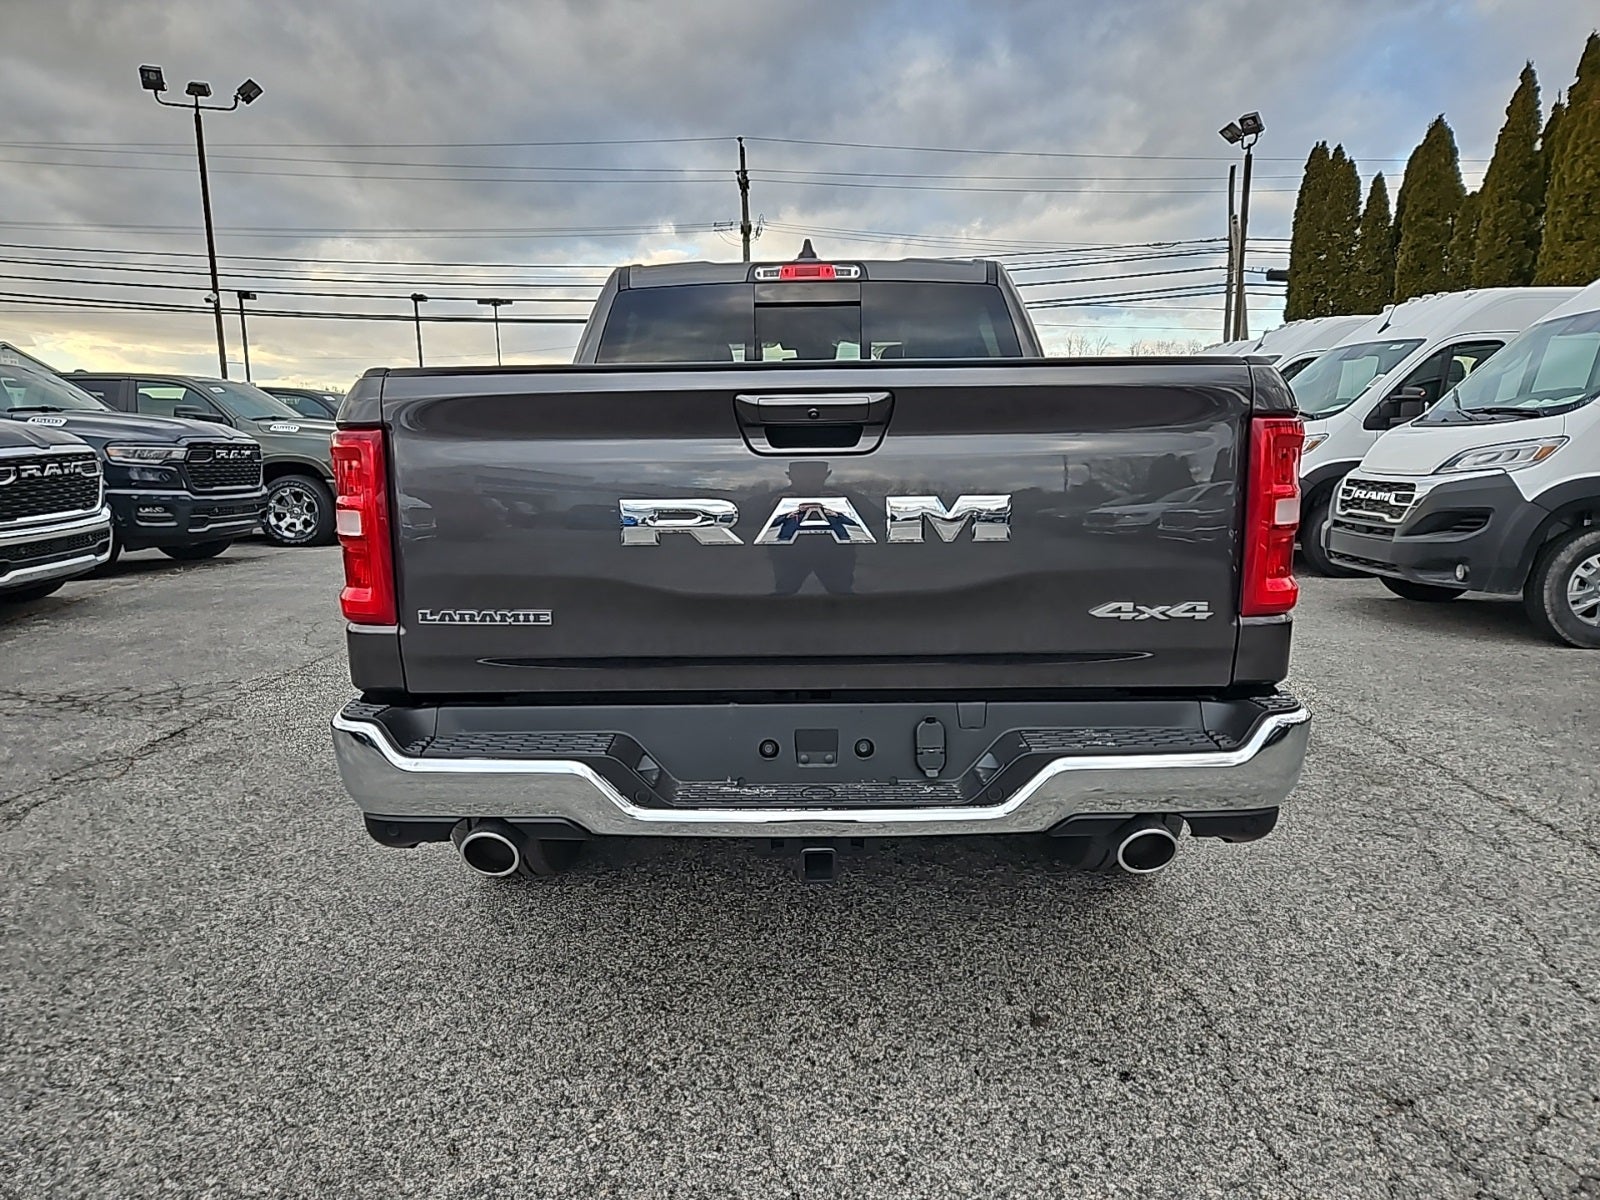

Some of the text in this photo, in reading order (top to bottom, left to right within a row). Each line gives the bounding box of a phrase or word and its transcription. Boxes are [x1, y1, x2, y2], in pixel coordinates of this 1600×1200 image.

[19, 462, 82, 478] RAM
[1353, 489, 1392, 502] RAM
[619, 495, 1012, 546] RAM
[417, 608, 553, 625] LARAMIE
[1088, 600, 1215, 620] 4x4
